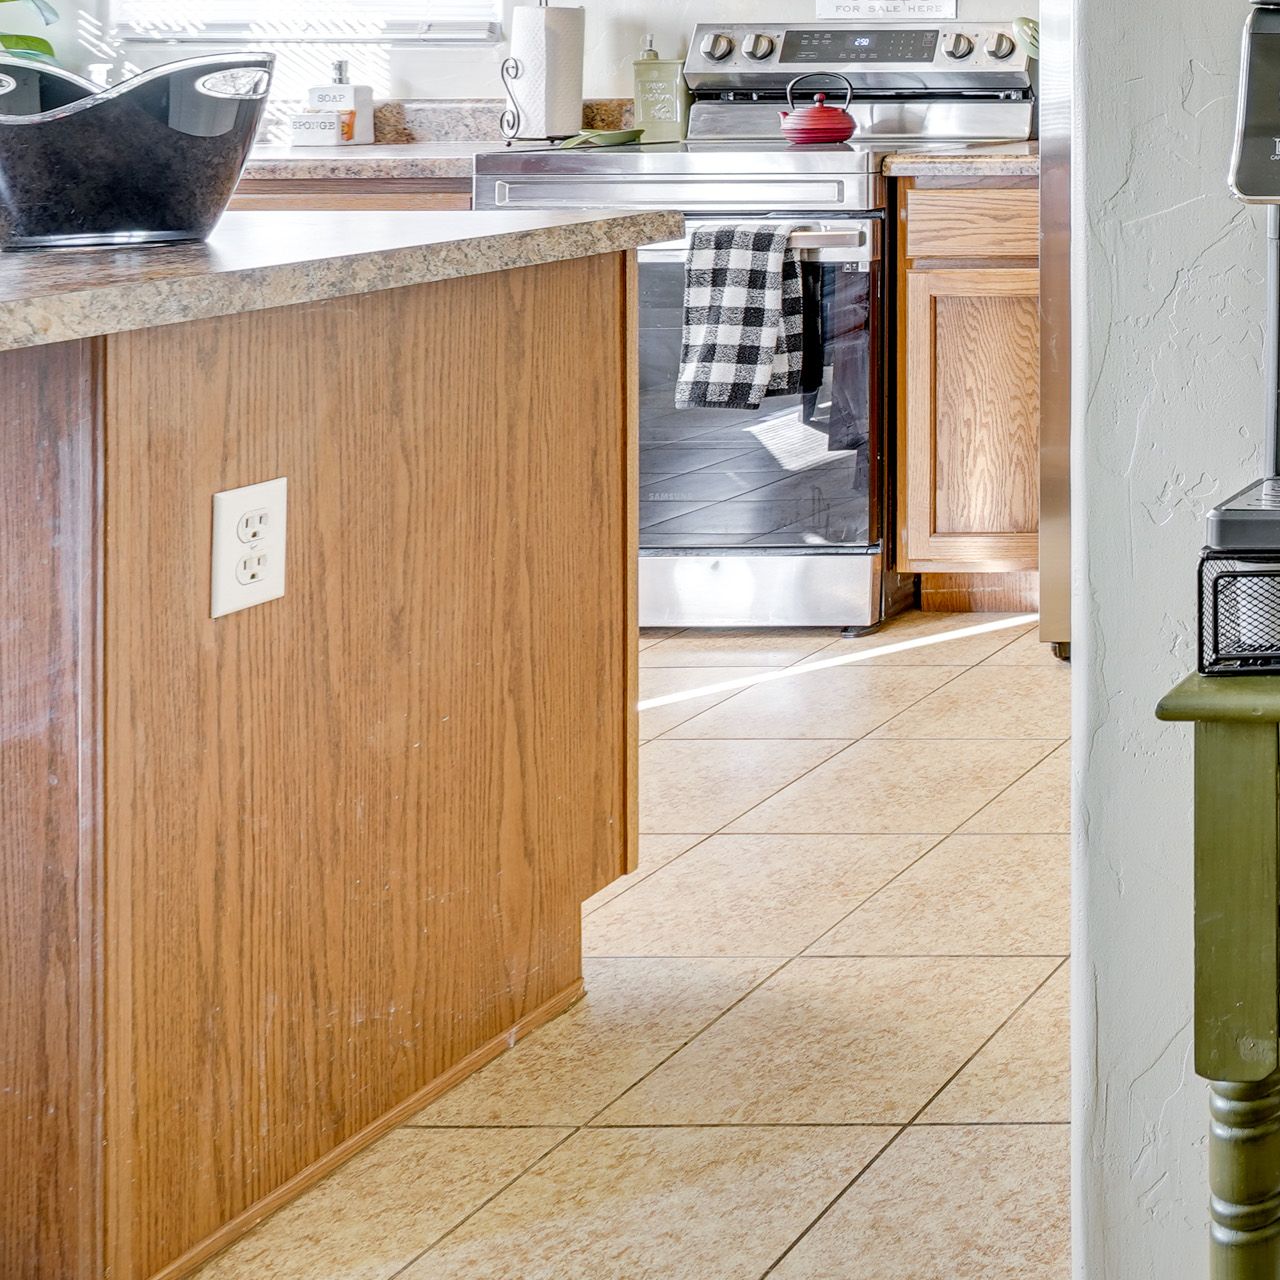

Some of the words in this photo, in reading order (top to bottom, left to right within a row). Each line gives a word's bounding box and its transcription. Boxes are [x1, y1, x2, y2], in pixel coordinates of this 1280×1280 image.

[835, 5, 860, 13] FOR
[868, 5, 901, 13] SALE
[907, 5, 943, 13] HERE
[317, 93, 346, 103] SOAP
[292, 120, 336, 130] SPONGE
